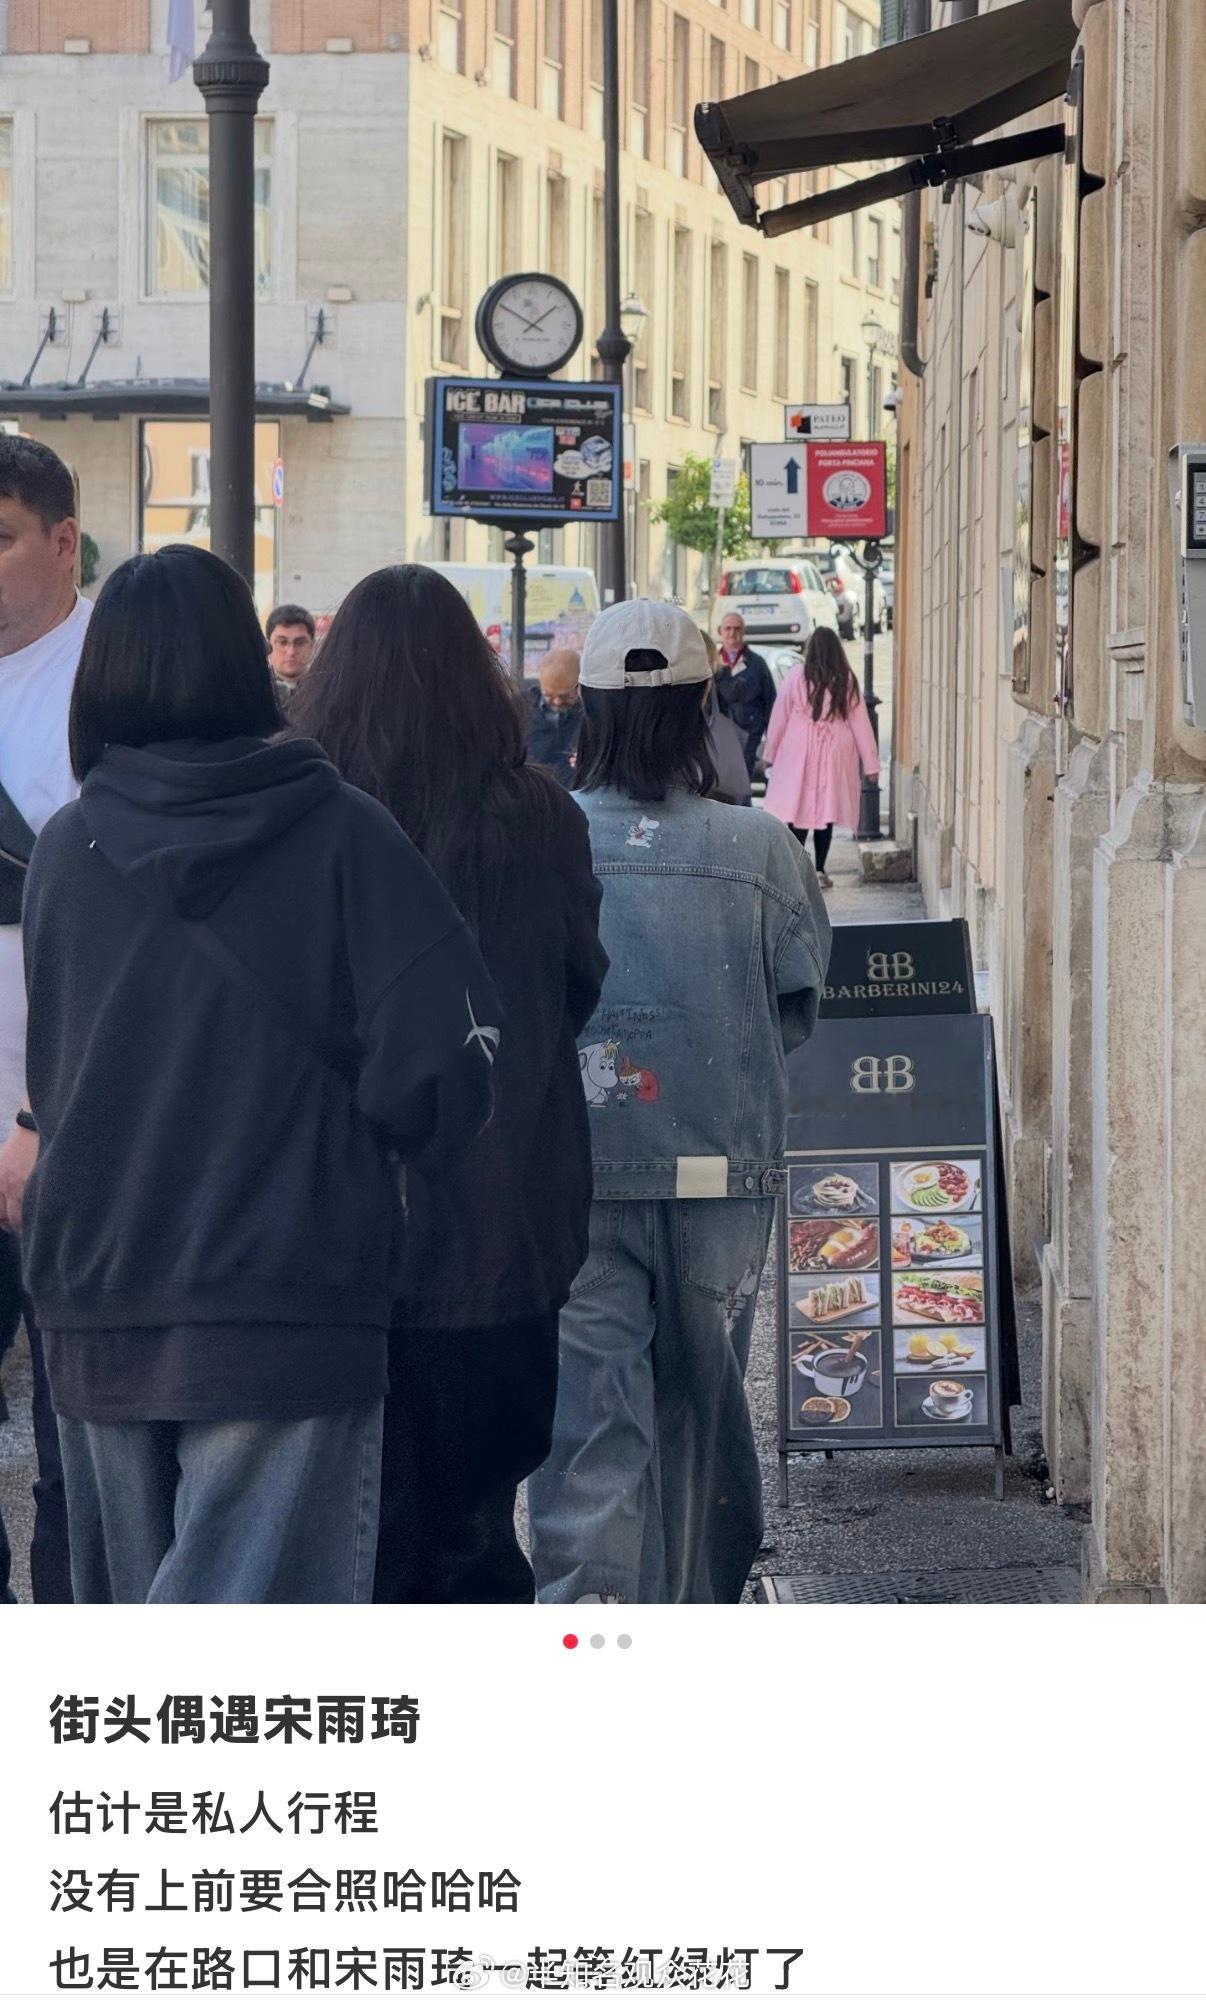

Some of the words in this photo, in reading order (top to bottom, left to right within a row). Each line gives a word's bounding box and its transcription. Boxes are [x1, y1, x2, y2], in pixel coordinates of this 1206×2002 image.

[446, 388, 480, 411] ICE
[484, 390, 526, 414] BAR
[813, 414, 846, 423] PATEO
[755, 479, 765, 487] 10
[823, 980, 964, 1000] BARBERINI24
